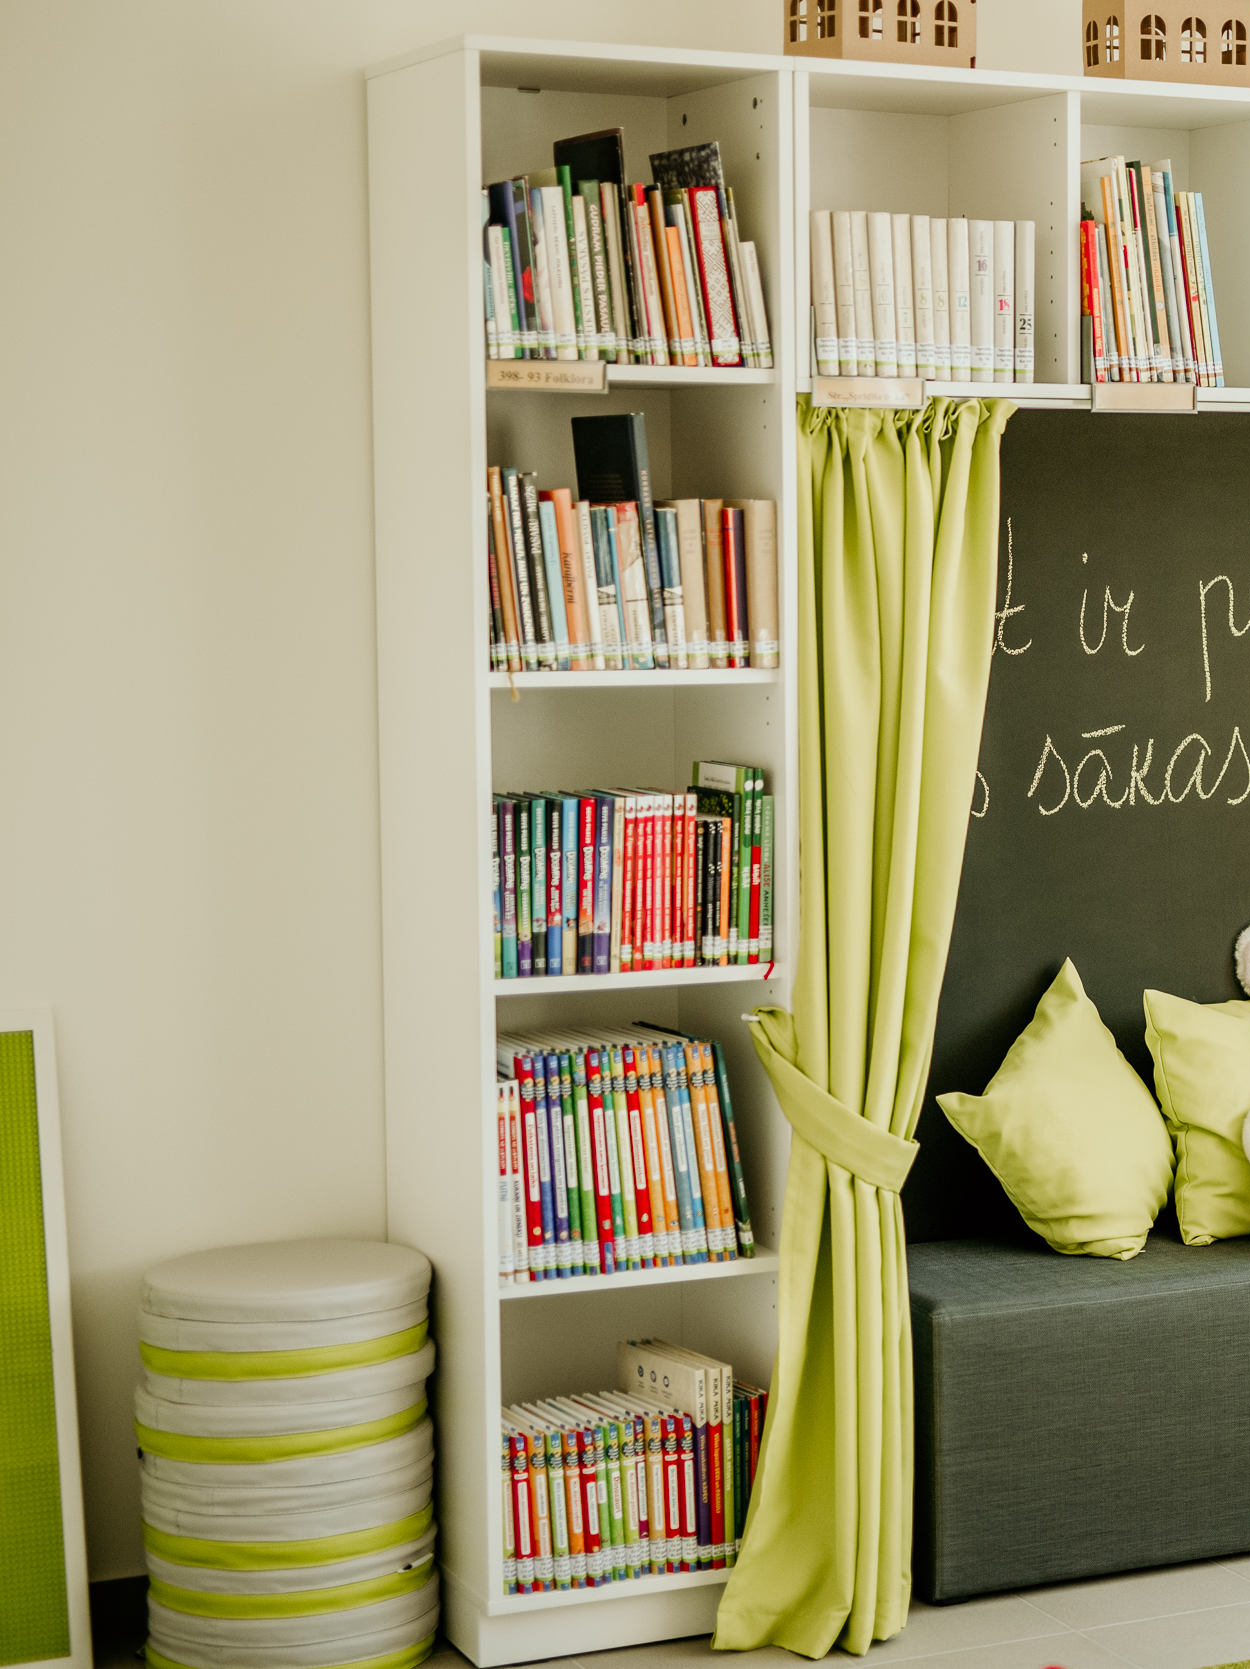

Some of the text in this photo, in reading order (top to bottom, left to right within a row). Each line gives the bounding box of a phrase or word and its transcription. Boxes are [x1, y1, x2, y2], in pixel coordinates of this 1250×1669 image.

[1145, 192, 1155, 226] Jautājumi
[1150, 233, 1159, 262] atbildes
[577, 230, 588, 282] PASAKAS
[589, 204, 610, 332] GUDRAM PIEDER PASAUL
[976, 259, 988, 272] 16
[919, 292, 927, 306] 8
[957, 295, 968, 308] 12
[998, 298, 1011, 312] 18
[1019, 318, 1032, 331] 25
[498, 370, 595, 384] 398- 93 Folklora
[524, 484, 536, 512] MEŽS
[640, 470, 651, 508] KURBADS
[528, 517, 540, 554] PASAKU
[559, 550, 577, 604] Karaļbērni
[1079, 552, 1145, 656] ir
[514, 1204, 520, 1212] UN
[712, 1400, 720, 1421] MIKA
[724, 1375, 732, 1418] KIKA MIKA
[698, 1402, 706, 1423] MIKA
[612, 1476, 622, 1513] Dinozauri
